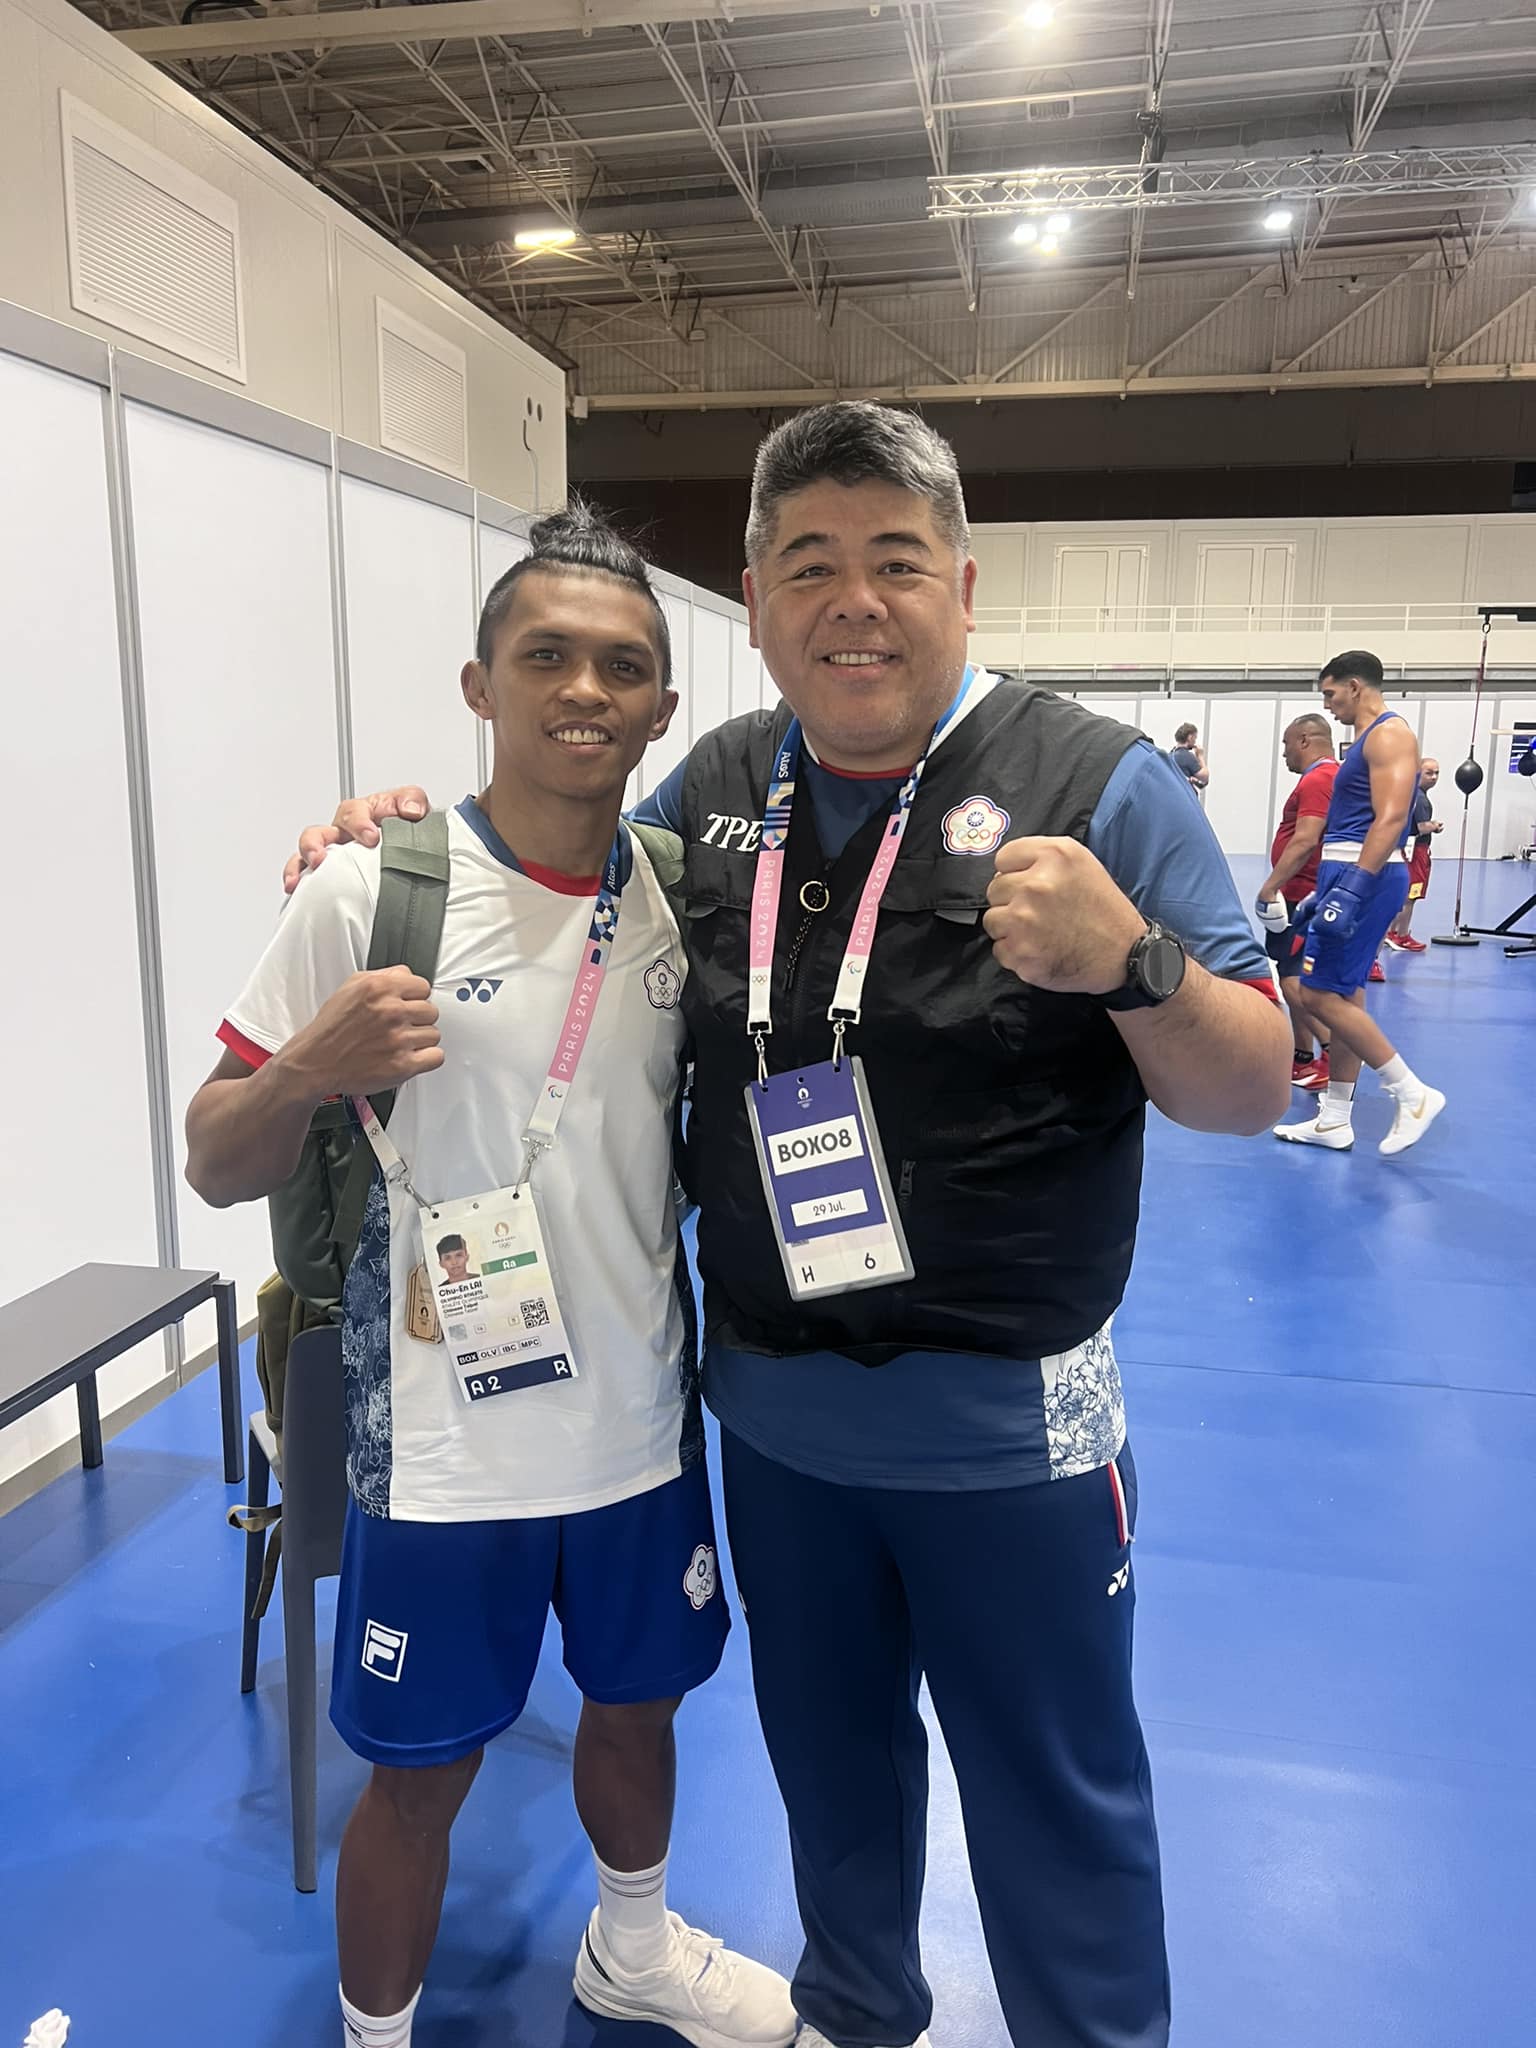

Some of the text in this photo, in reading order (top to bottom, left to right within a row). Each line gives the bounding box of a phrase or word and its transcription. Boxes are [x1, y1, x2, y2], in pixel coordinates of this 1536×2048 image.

[778, 751, 791, 779] Atos
[700, 812, 765, 852] TPE
[607, 862, 616, 890] Atos
[759, 860, 776, 906] PARIS
[855, 895, 876, 946] PARIS
[559, 972, 597, 1073] PARIS 2024
[813, 1205, 827, 1216] 29
[502, 1260, 517, 1269] Aa
[801, 1253, 876, 1283] H 6
[459, 1339, 539, 1364] BOX OLV IBC MPC
[470, 1360, 569, 1396] A 2 R
